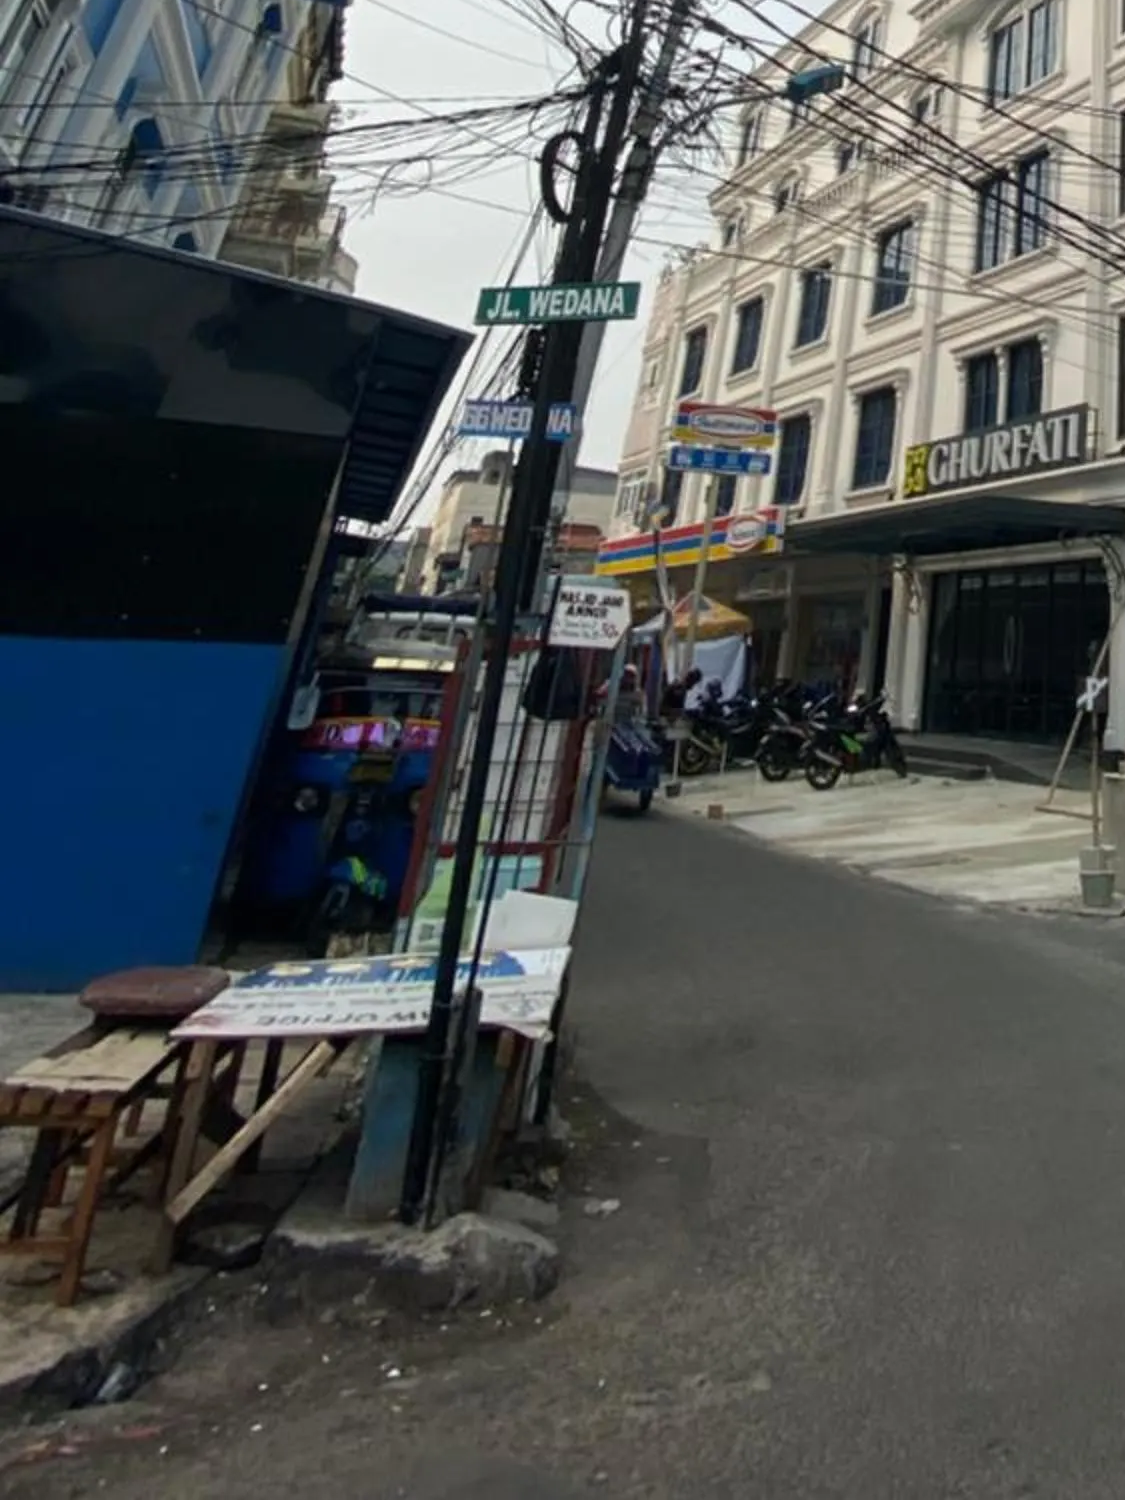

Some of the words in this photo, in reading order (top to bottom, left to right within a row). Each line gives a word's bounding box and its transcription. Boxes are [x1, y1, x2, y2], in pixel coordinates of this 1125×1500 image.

[486, 291, 521, 320] JL.
[528, 286, 626, 318] WEDANA
[490, 405, 573, 434] WEDNA
[928, 413, 1082, 486] GHURFATI
